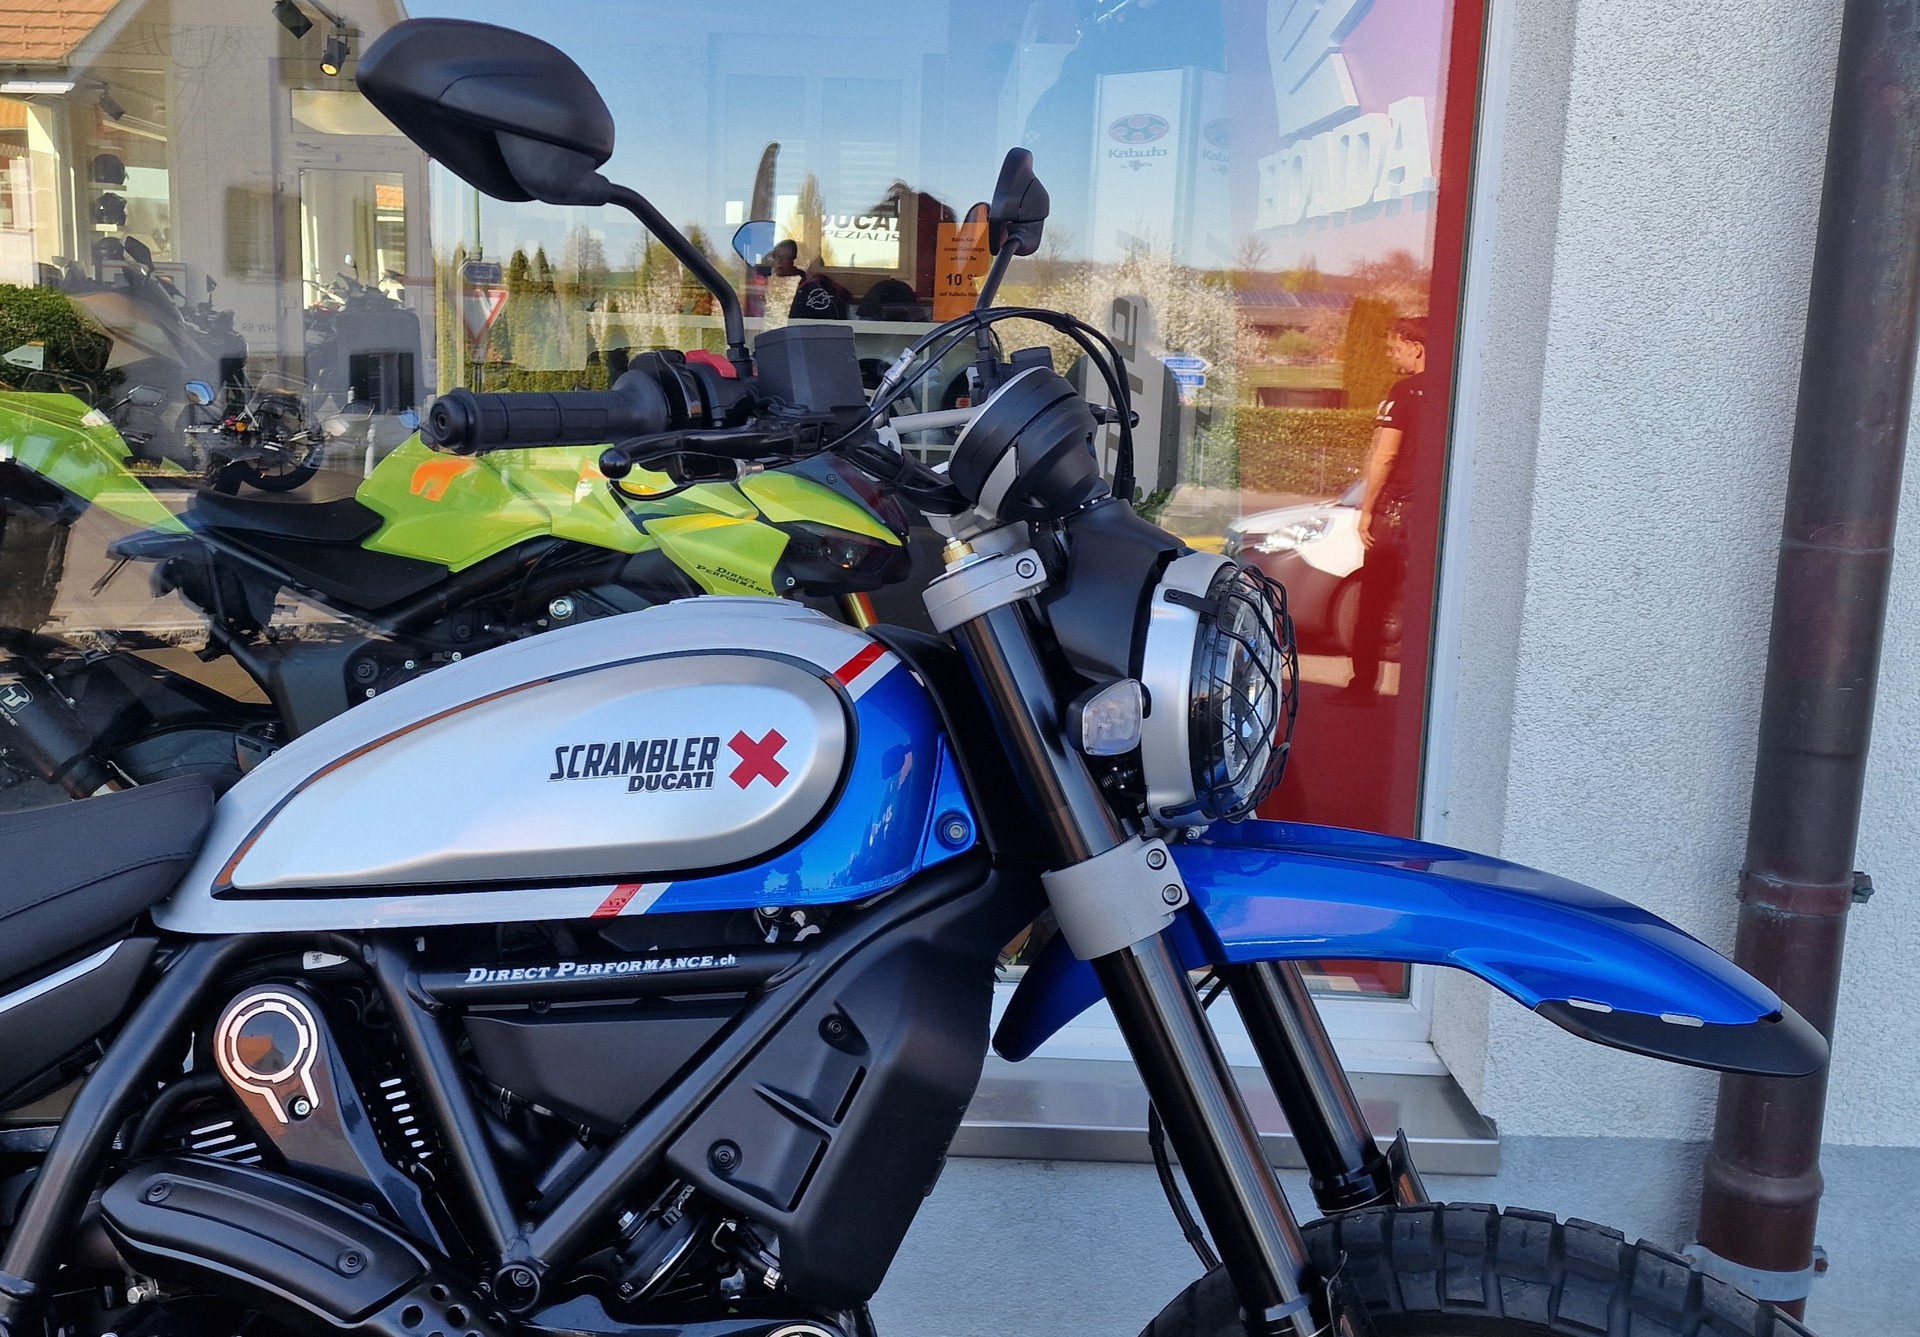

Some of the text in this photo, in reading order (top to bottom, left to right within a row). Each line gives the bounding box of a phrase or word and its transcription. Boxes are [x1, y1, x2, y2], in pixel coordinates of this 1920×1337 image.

[1108, 147, 1167, 158] Kabuto
[1255, 96, 1437, 231] HONDA
[822, 230, 899, 241] PEZIALIS
[946, 273, 962, 286] 10
[696, 564, 775, 596] PERFORMANCE
[716, 566, 758, 585] DIRECT
[549, 736, 721, 780] SCRAMBLER
[627, 771, 714, 792] DUCATI
[464, 954, 736, 983] DIRECT PERFORMANCE.ch
